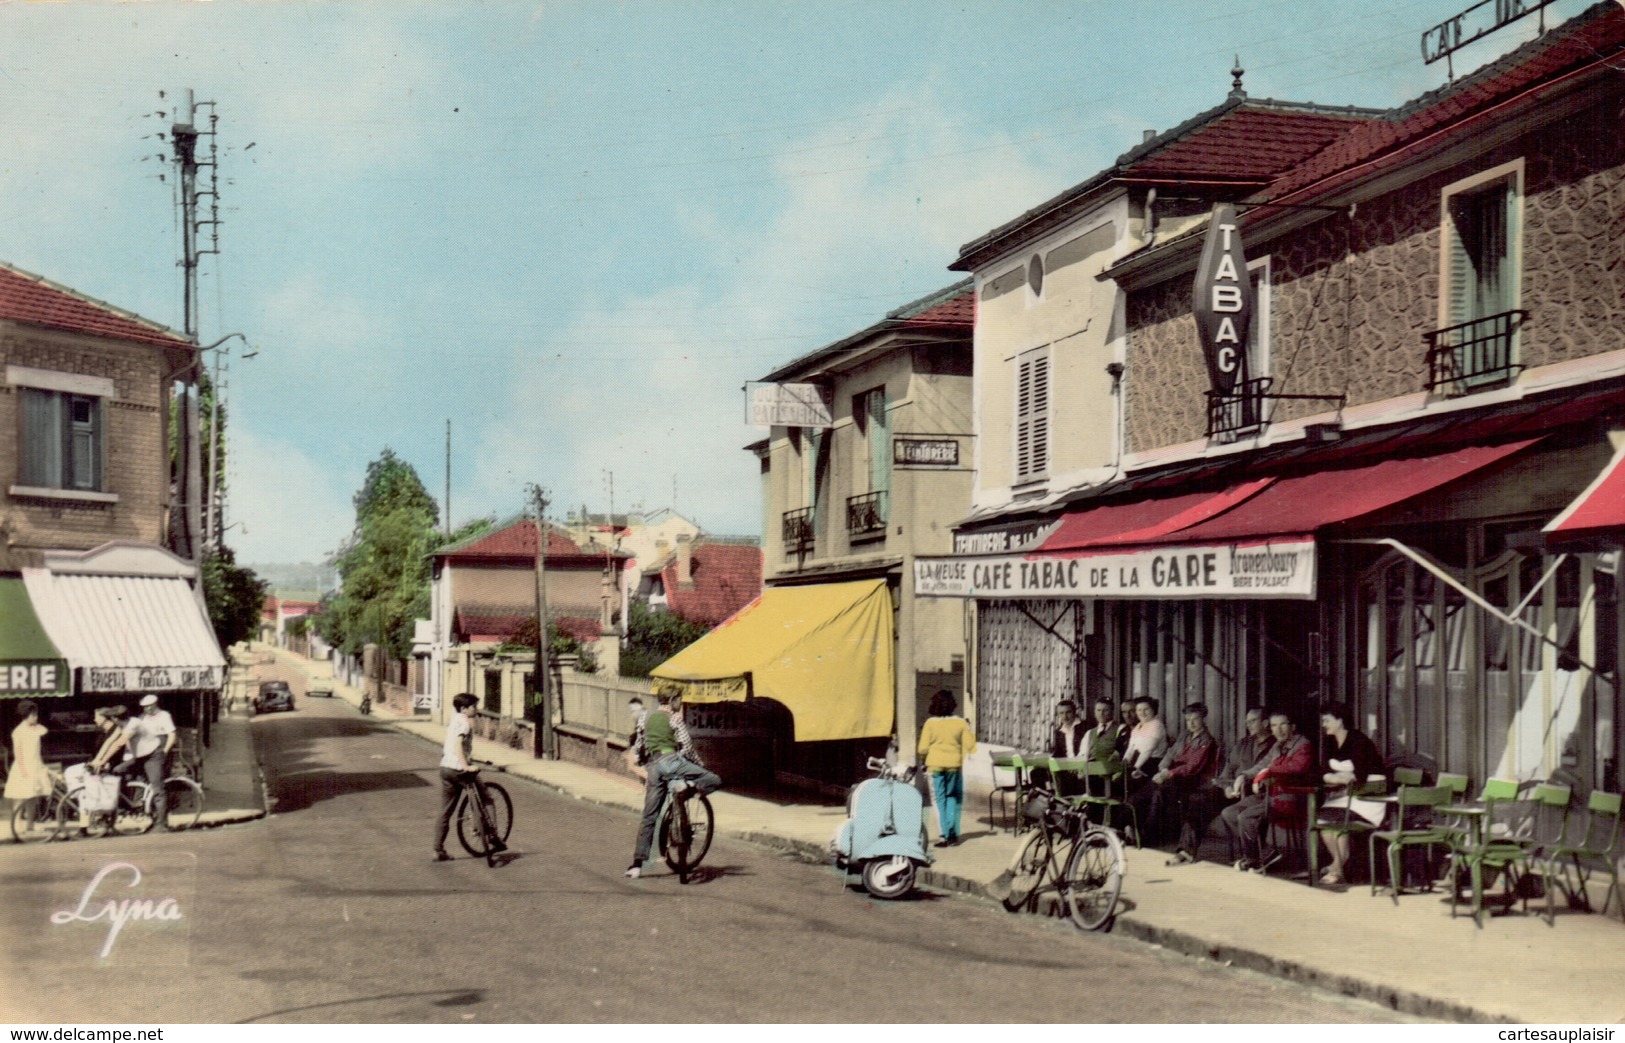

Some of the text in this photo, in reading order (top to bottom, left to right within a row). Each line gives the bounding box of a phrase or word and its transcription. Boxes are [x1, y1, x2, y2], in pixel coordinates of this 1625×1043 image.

[1212, 224, 1243, 372] TABAC
[1009, 533, 1021, 551] DE
[920, 561, 967, 581] LA MEUSE
[973, 553, 1217, 590] CAFÉ TABAC DE LA GARE
[1229, 543, 1298, 577] Kronenbourg
[0, 666, 56, 690] ERIE
